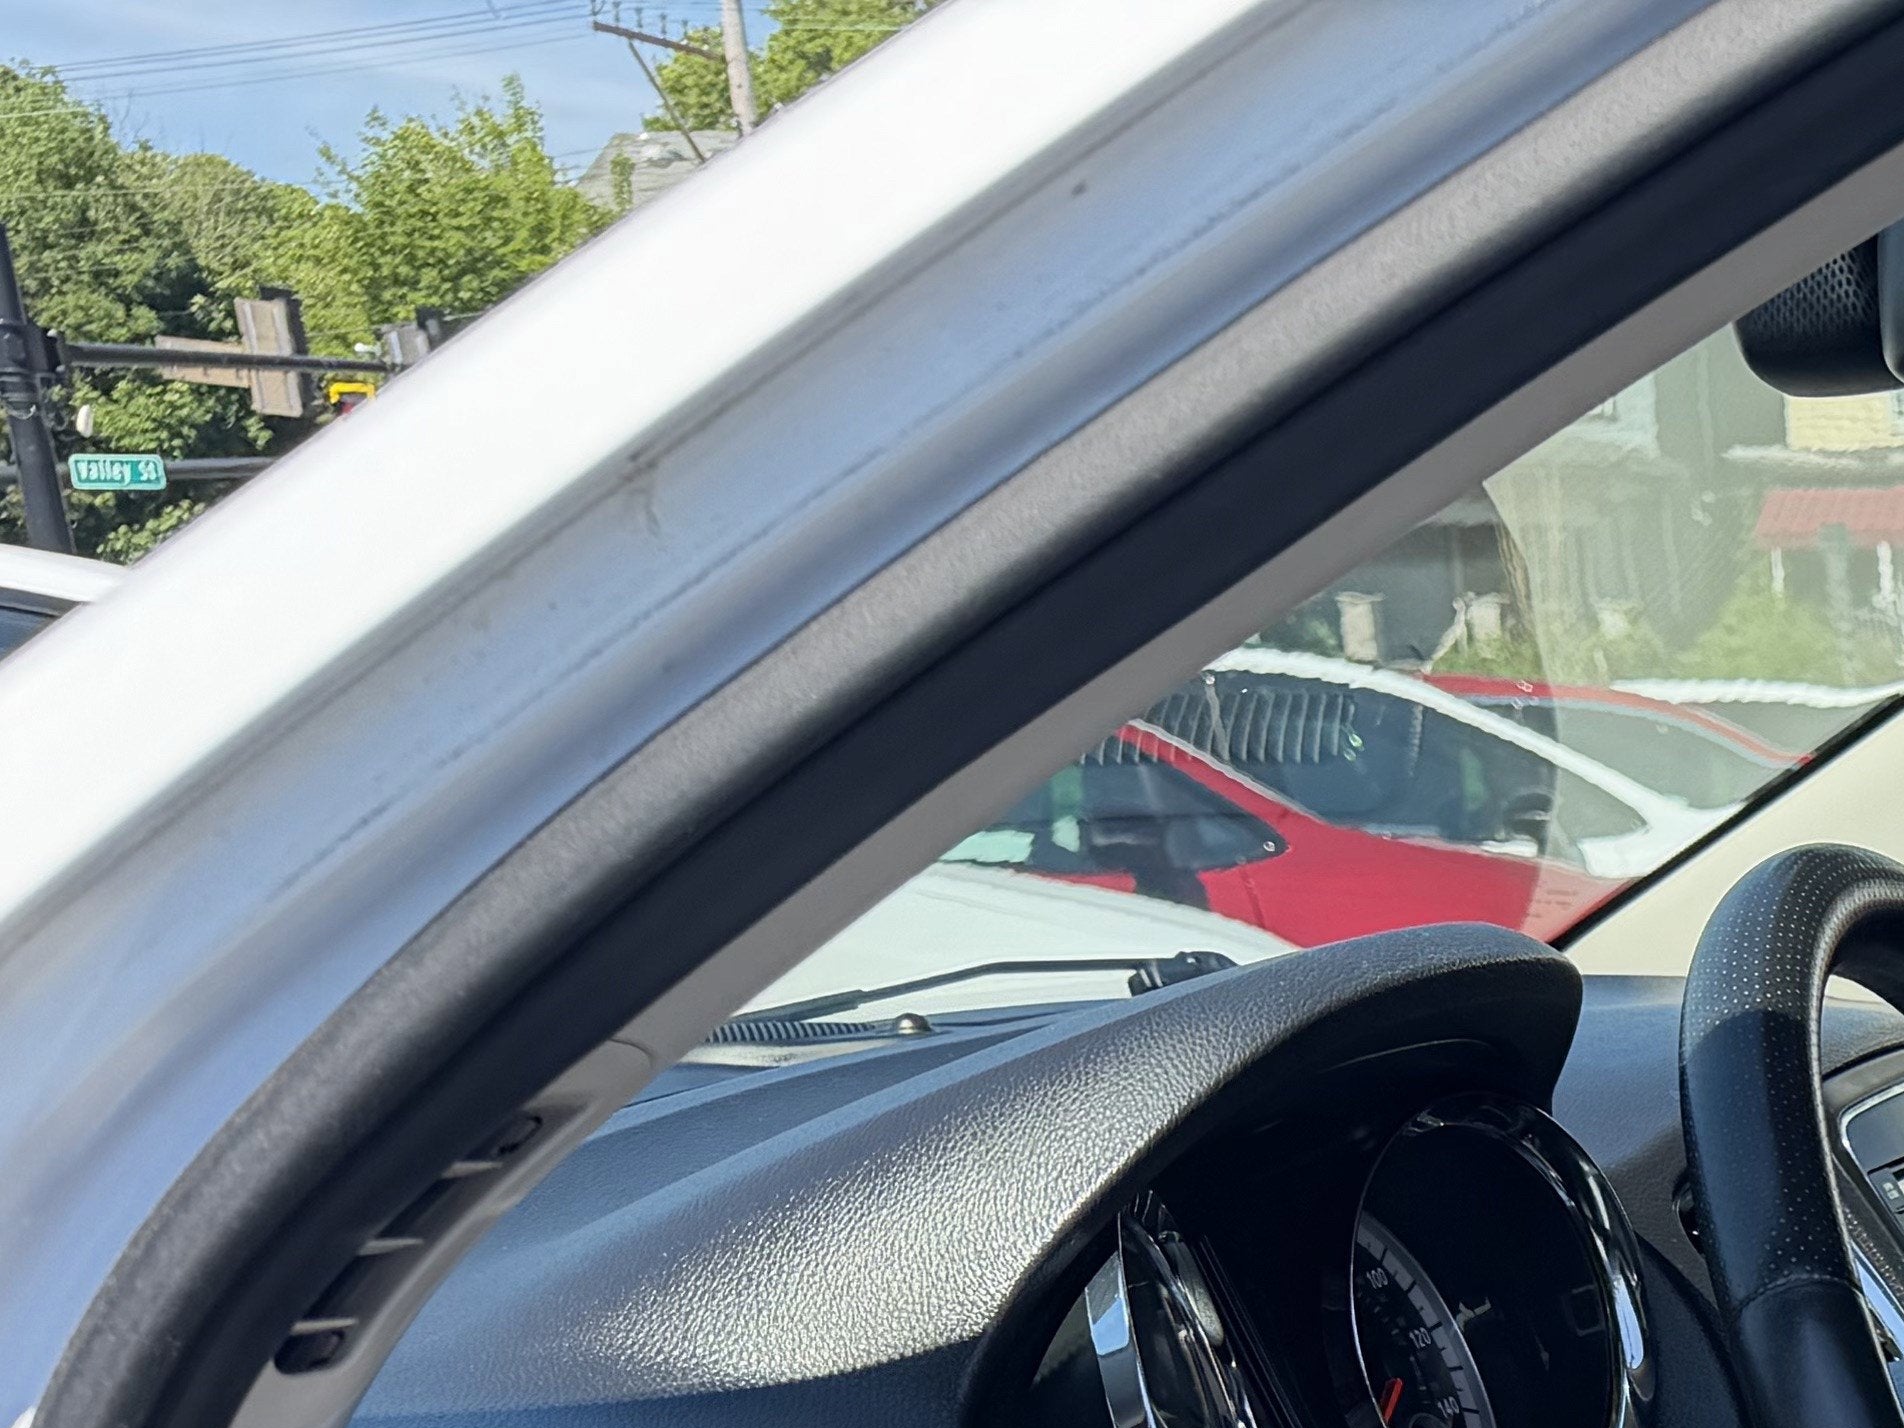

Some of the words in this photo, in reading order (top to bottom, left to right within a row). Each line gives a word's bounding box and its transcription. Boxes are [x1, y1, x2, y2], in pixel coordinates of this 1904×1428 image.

[77, 460, 132, 486] Valley
[1366, 1267, 1389, 1289] 100
[1409, 1326, 1432, 1349] 120
[1437, 1396, 1460, 1419] 140
